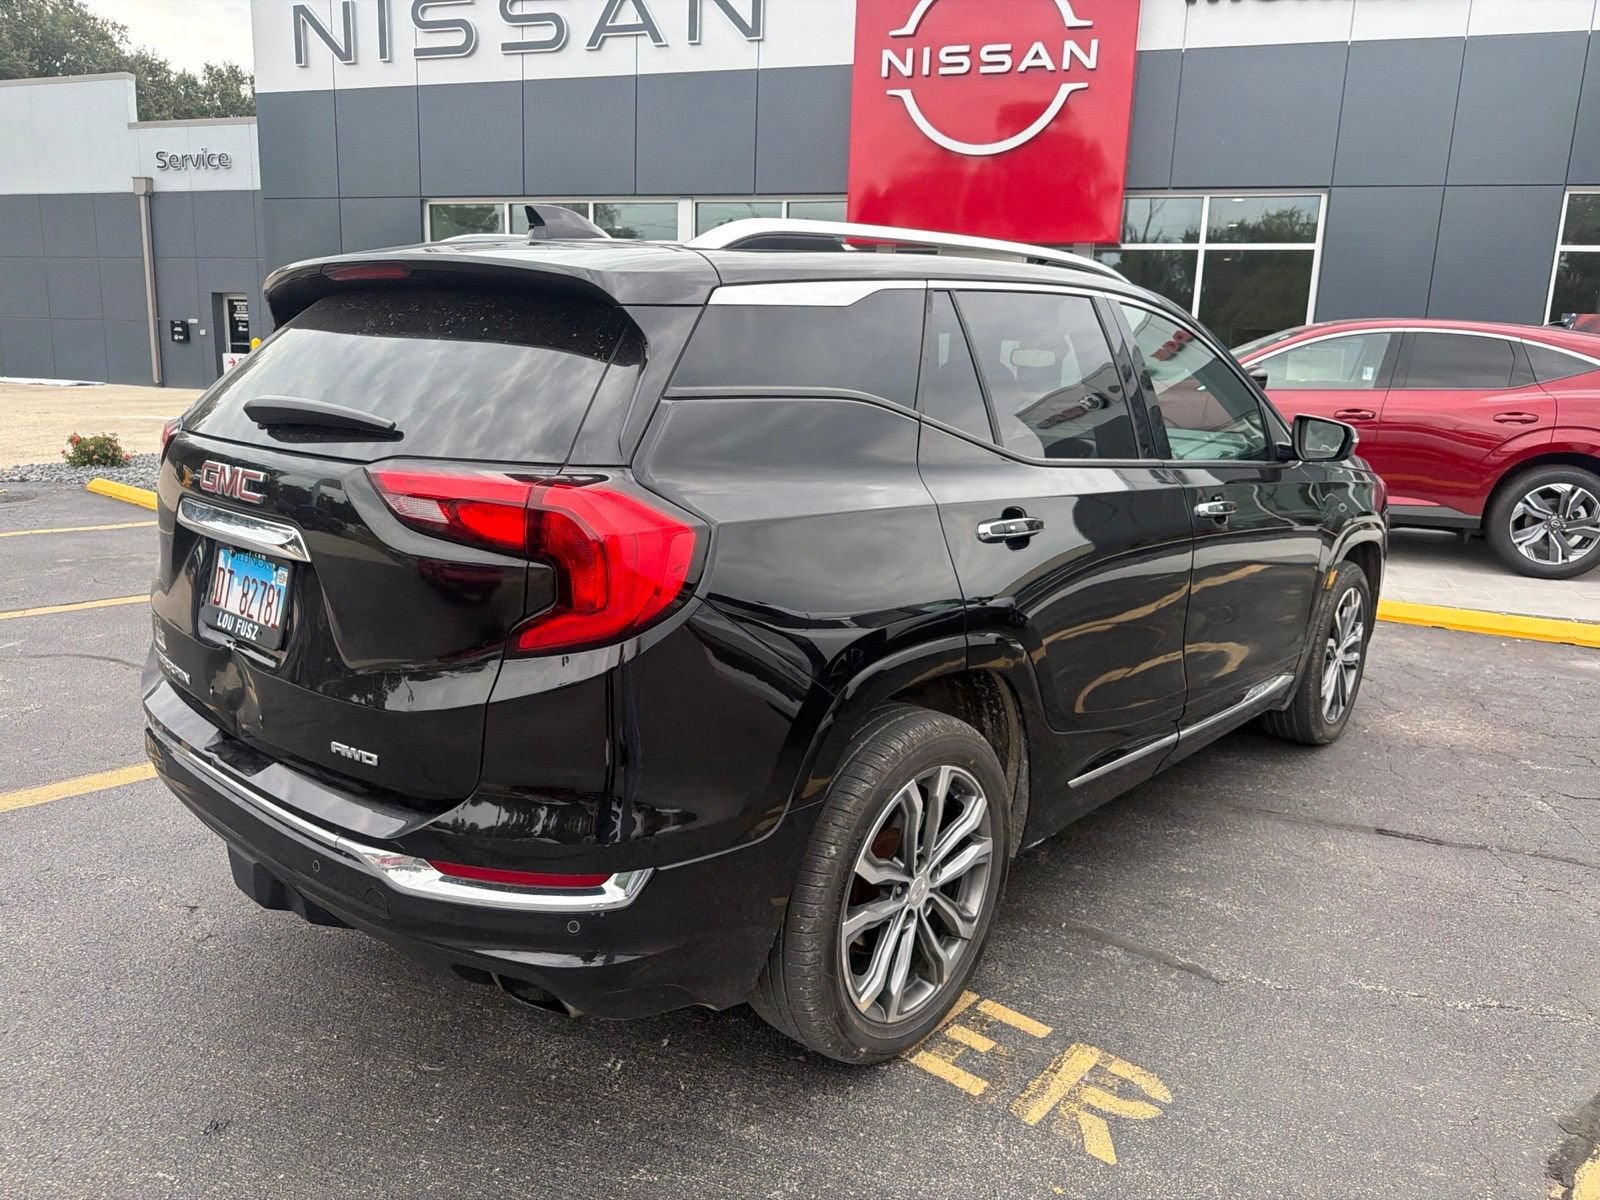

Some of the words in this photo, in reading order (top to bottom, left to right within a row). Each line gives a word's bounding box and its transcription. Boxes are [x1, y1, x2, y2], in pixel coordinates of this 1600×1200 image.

[292, 0, 764, 67] NISSAN
[880, 38, 1099, 79] NISSAN
[155, 148, 231, 171] Service
[199, 460, 266, 504] GMC
[213, 566, 235, 609] DT
[239, 575, 282, 631] 82781
[216, 611, 235, 631] LOU
[234, 618, 260, 641] FUSZ
[330, 740, 379, 767] AWD
